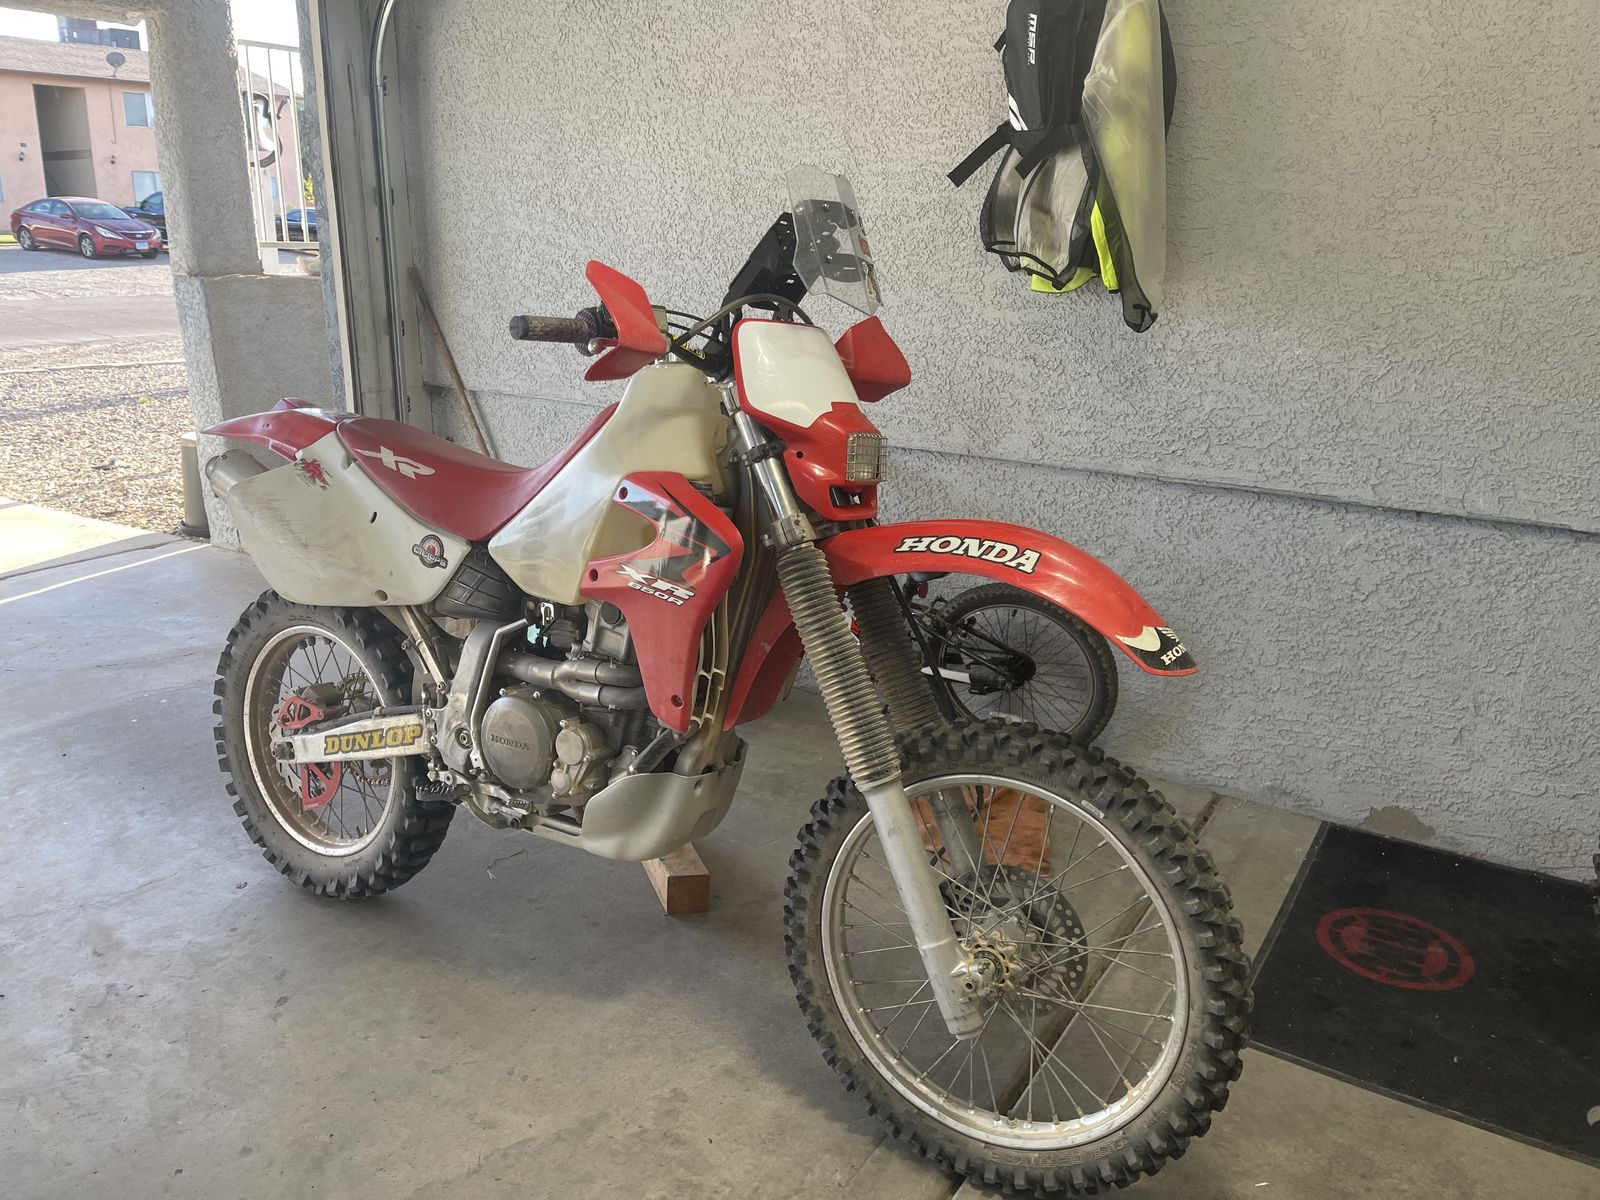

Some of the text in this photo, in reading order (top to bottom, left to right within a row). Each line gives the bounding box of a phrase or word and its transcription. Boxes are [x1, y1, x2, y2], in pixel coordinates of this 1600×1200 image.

[894, 535, 1042, 574] HONDA
[616, 563, 695, 600] XR
[628, 581, 684, 606] 650R
[325, 724, 422, 755] DUNLOP
[490, 734, 529, 751] HONDA
